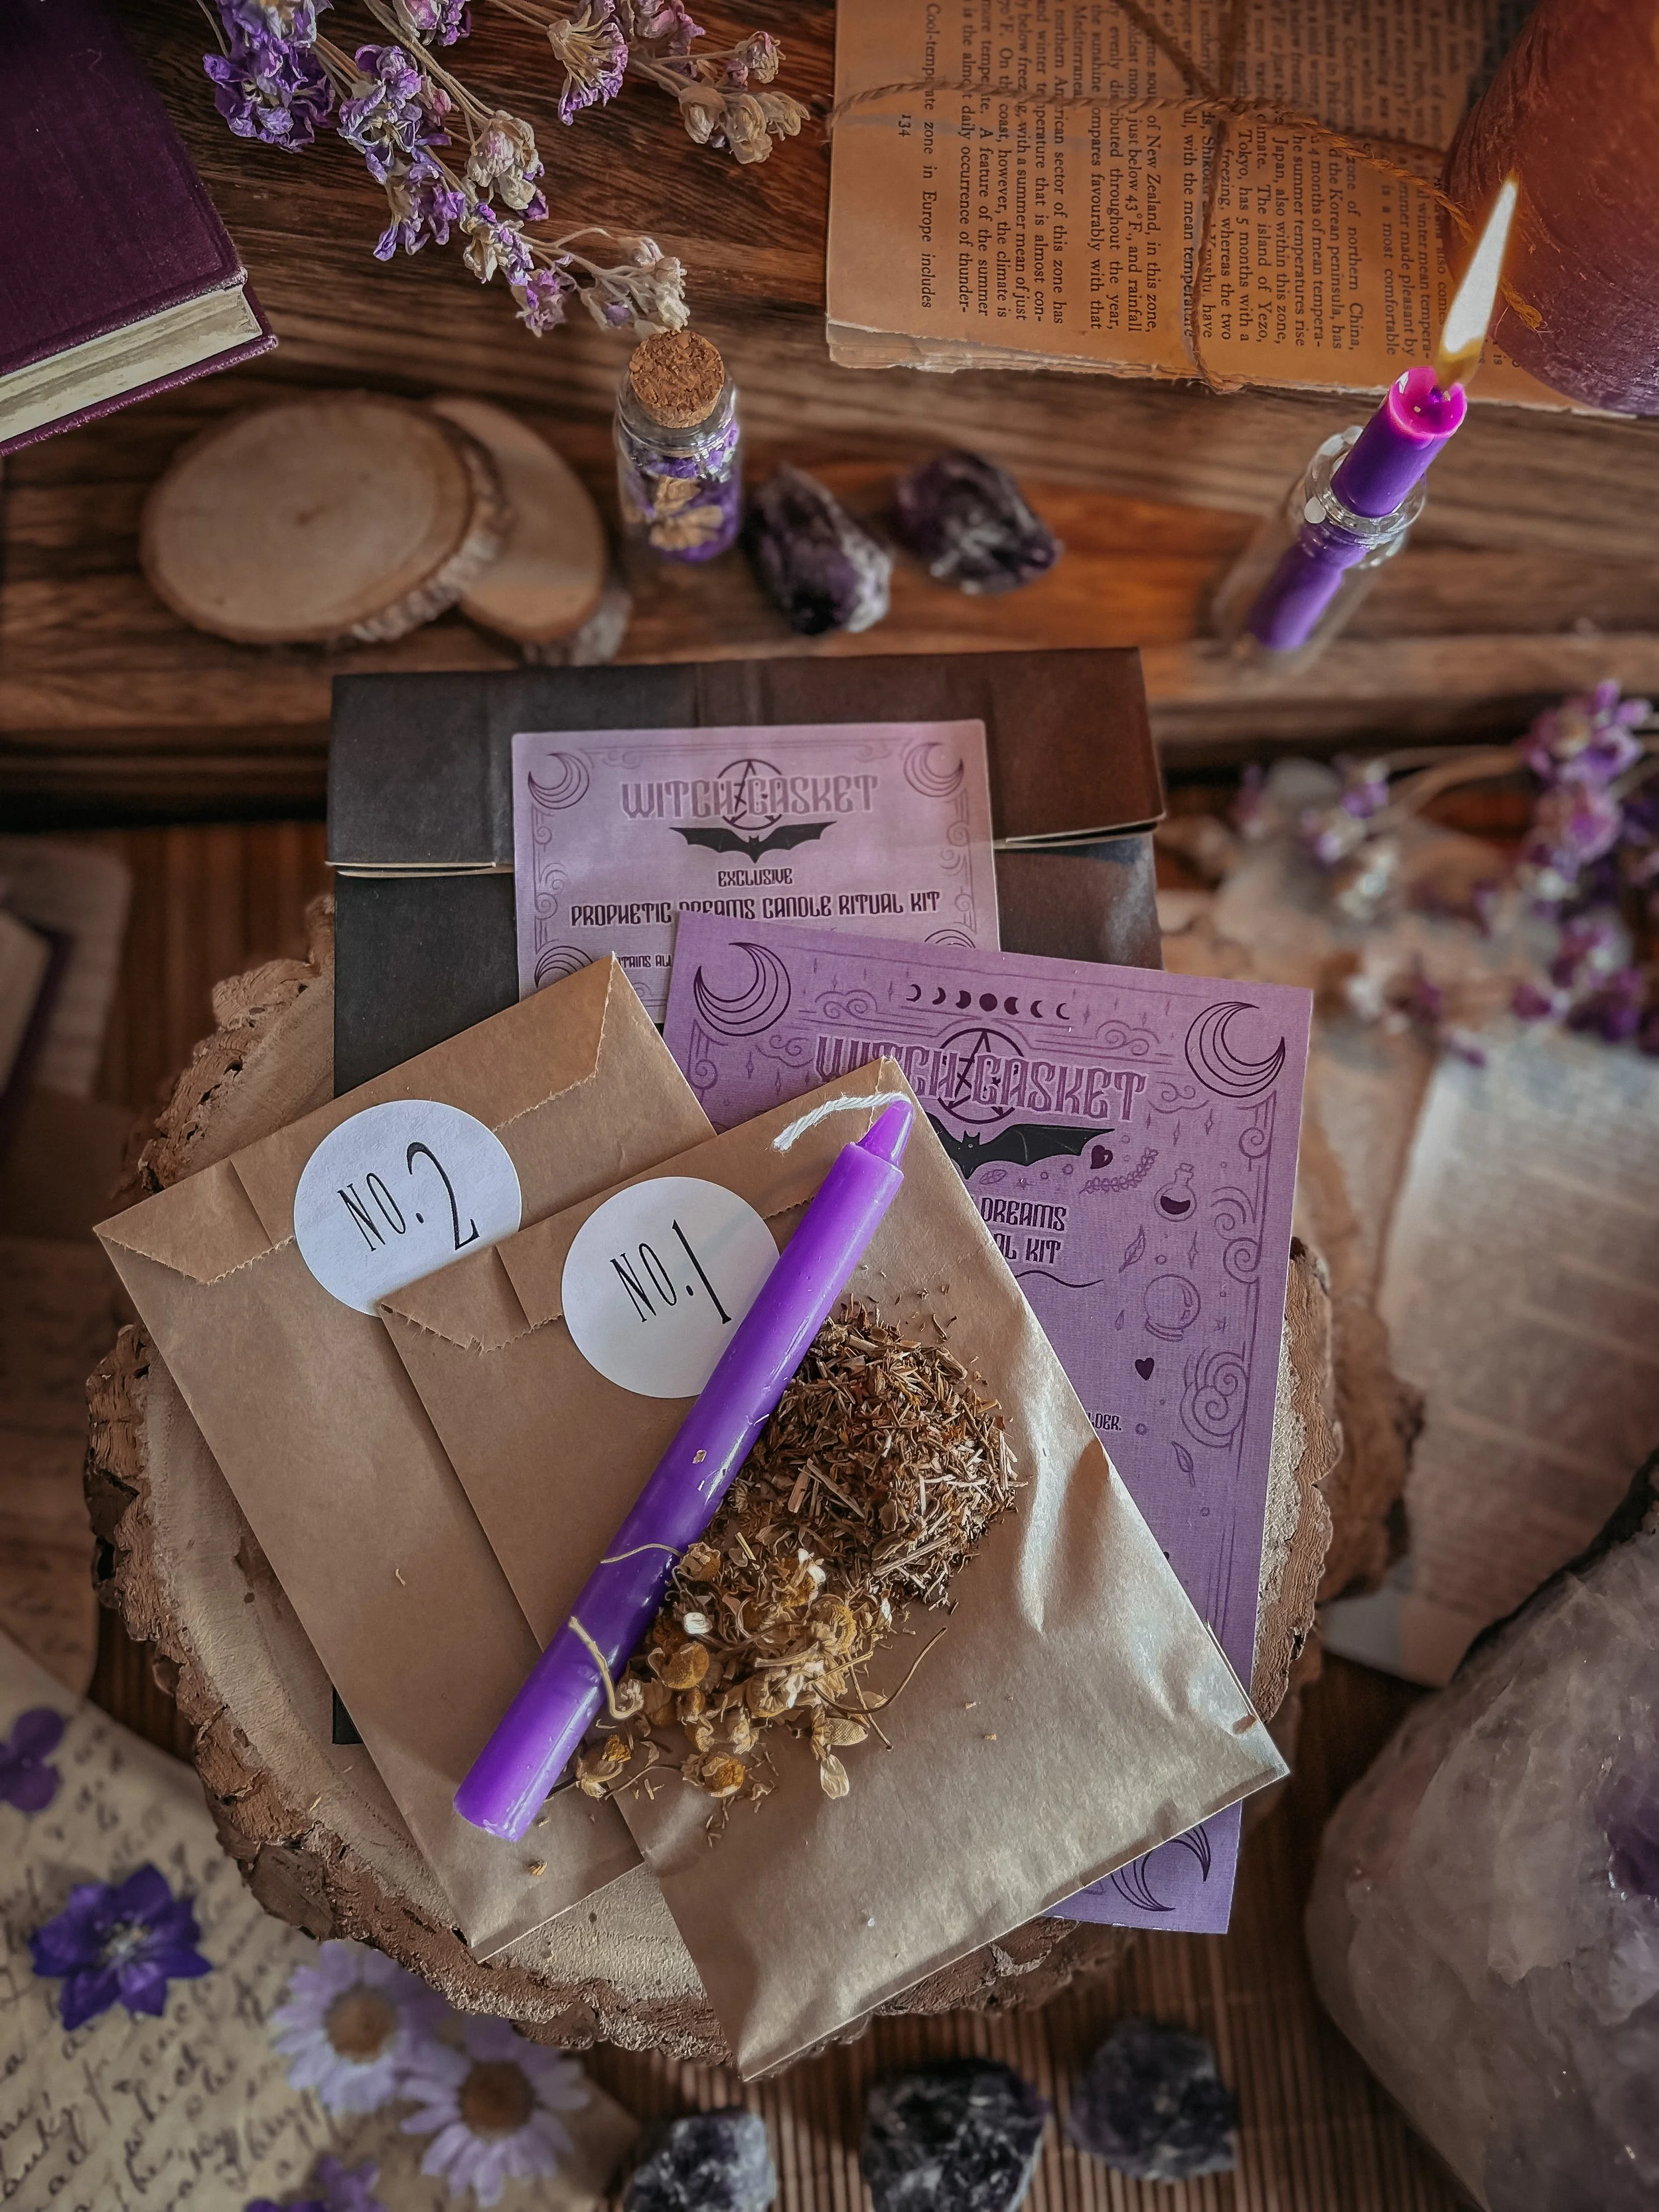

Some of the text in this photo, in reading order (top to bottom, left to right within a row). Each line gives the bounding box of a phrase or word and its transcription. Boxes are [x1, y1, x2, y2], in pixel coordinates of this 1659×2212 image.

[1018, 14, 1032, 51] below
[1055, 10, 1069, 68] northern
[1107, 27, 1123, 69] evenly
[999, 48, 1013, 68] On
[1037, 31, 1049, 74] winter
[1092, 32, 1106, 92] sunshine
[999, 75, 1013, 95] th
[924, 122, 934, 154] zone
[980, 127, 993, 139] A
[996, 104, 1008, 143] coast,
[1017, 123, 1031, 153] with
[1089, 108, 1102, 166] ompares
[1127, 117, 1142, 145] just
[1147, 116, 1161, 130] of
[958, 9, 978, 313] is the almot daily occurrence of thunder-
[1147, 136, 1161, 169] New
[1183, 136, 1197, 166] with
[1236, 129, 1252, 180] Tokyo,
[922, 165, 937, 179] in
[979, 147, 993, 197] feature
[995, 149, 1011, 214] however,
[1054, 152, 1066, 194] sector
[1128, 149, 1142, 191] below
[1183, 173, 1197, 194] the
[1294, 156, 1304, 215] summer
[1329, 163, 1340, 184] the
[1017, 170, 1027, 229] summer
[1036, 177, 1048, 206] that
[1239, 187, 1252, 210] has
[1258, 185, 1271, 214] The
[1311, 161, 1325, 214] months
[918, 191, 937, 242] Europe
[978, 206, 993, 221] of
[1036, 214, 1048, 226] is
[1054, 202, 1068, 218] of
[1088, 174, 1105, 252] favourably
[1107, 169, 1123, 250] throughout
[1145, 174, 1161, 236] Zealand,
[1184, 200, 1193, 240] mean
[1329, 189, 1342, 241] Korean
[978, 229, 992, 251] the
[997, 222, 1011, 244] the
[1053, 226, 1068, 252] this
[1273, 138, 1290, 344] Japan, also within this zone,
[1313, 219, 1325, 234] of
[1383, 224, 1393, 259] most
[1017, 234, 1026, 271] mean
[1035, 235, 1048, 283] almost
[1128, 246, 1142, 273] and
[1147, 242, 1161, 256] in
[1221, 218, 1233, 276] whereas
[1239, 232, 1252, 287] months
[1258, 223, 1271, 266] island
[1346, 157, 1364, 350] zone of northern China,
[1401, 232, 1413, 270] made
[921, 254, 936, 308] includes
[997, 252, 1011, 301] climate
[1016, 277, 1029, 291] of
[1053, 260, 1063, 293] zone
[1090, 259, 1104, 291] with
[1110, 261, 1123, 284] the
[1147, 262, 1161, 288] this
[1291, 220, 1305, 314] temperatures
[1327, 246, 1344, 320] peninsula,
[1417, 203, 1433, 359] winter mean tempera-
[978, 260, 989, 316] summer
[1221, 283, 1233, 306] the
[1258, 277, 1271, 292] of
[997, 308, 1011, 317] is
[1013, 293, 1030, 320] just
[1036, 291, 1045, 322] con-
[1053, 301, 1067, 324] has
[1090, 301, 1104, 329] that
[1106, 295, 1119, 330] year,
[1128, 279, 1143, 332] rainfall
[1145, 294, 1157, 332] zone,
[1203, 304, 1216, 338] have
[1239, 294, 1252, 327] with
[1310, 281, 1323, 348] tempera-
[1384, 269, 1398, 355] comfortable
[1400, 275, 1415, 333] pleasant
[1222, 313, 1232, 340] two
[1256, 302, 1272, 342] Yezo,
[1295, 321, 1309, 346] rise
[1332, 325, 1344, 349] has
[1402, 338, 1418, 356] by
[717, 867, 793, 887] EXCLUSIVE
[570, 901, 673, 927] PROPHETIC
[762, 896, 832, 921] CANDLE
[838, 893, 904, 916] RITUAL
[910, 891, 940, 914] KIT
[981, 1197, 1067, 1231] DREAMS
[1026, 1238, 1061, 1264] KIT
